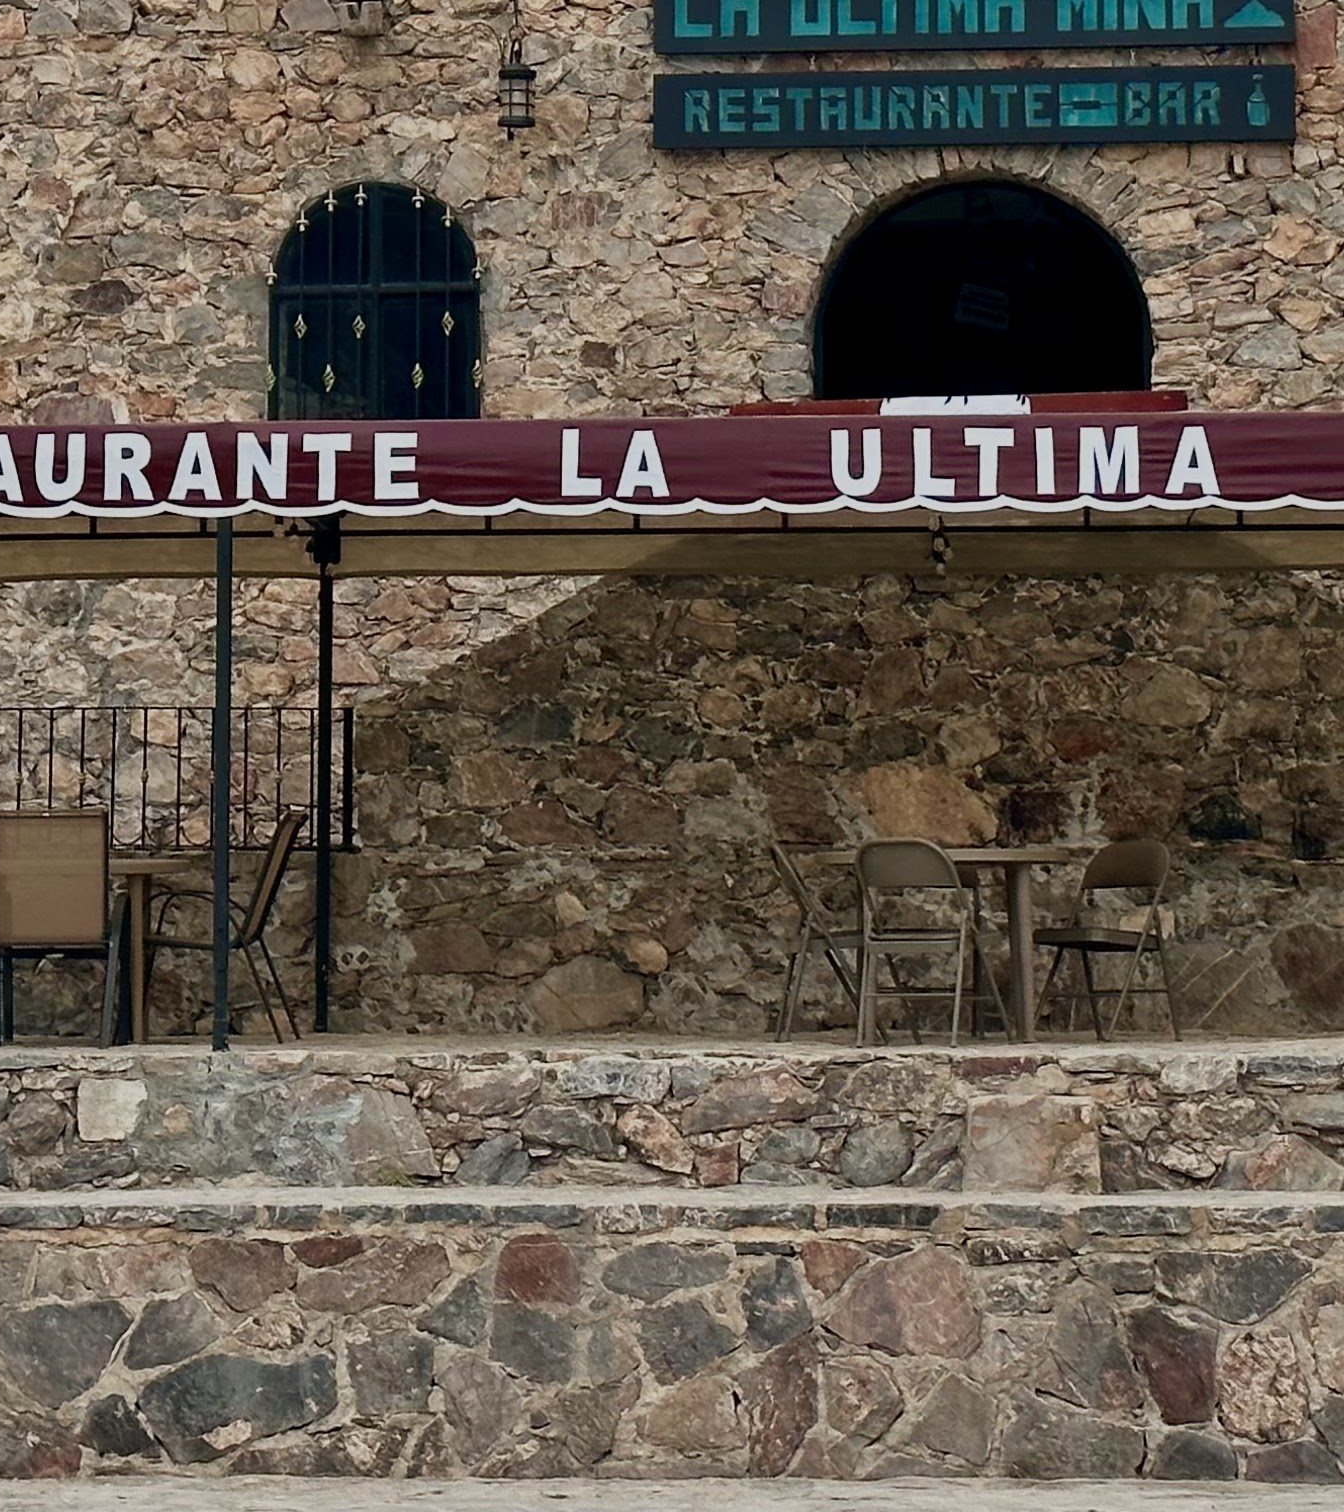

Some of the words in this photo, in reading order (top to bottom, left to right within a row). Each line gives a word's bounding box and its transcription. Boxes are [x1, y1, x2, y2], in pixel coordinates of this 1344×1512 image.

[683, 82, 1052, 133] RESTAURANTE
[1123, 81, 1222, 127] BAR
[561, 428, 670, 498] LA
[830, 425, 1221, 498] ULTIMA
